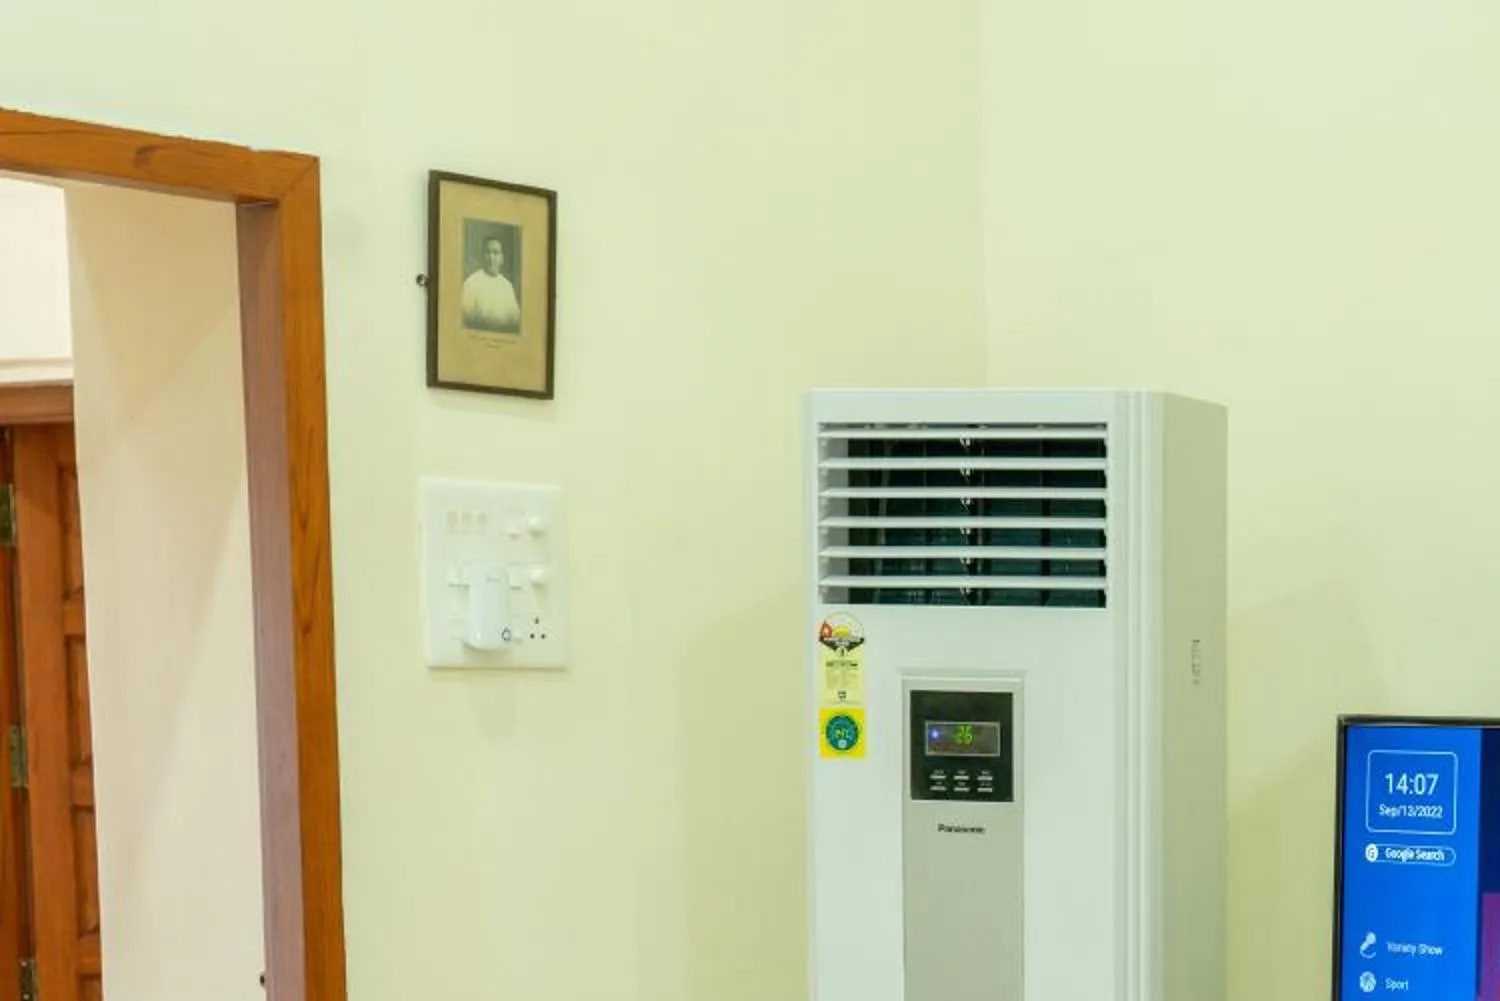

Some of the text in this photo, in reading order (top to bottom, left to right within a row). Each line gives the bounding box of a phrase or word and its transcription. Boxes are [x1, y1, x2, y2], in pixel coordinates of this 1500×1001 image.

[1385, 772, 1439, 796] 14:07
[1379, 803, 1443, 819] Sep/13/2022
[1385, 847, 1445, 863] Google Search
[1418, 943, 1443, 957] Show
[1384, 977, 1409, 992] Sport
